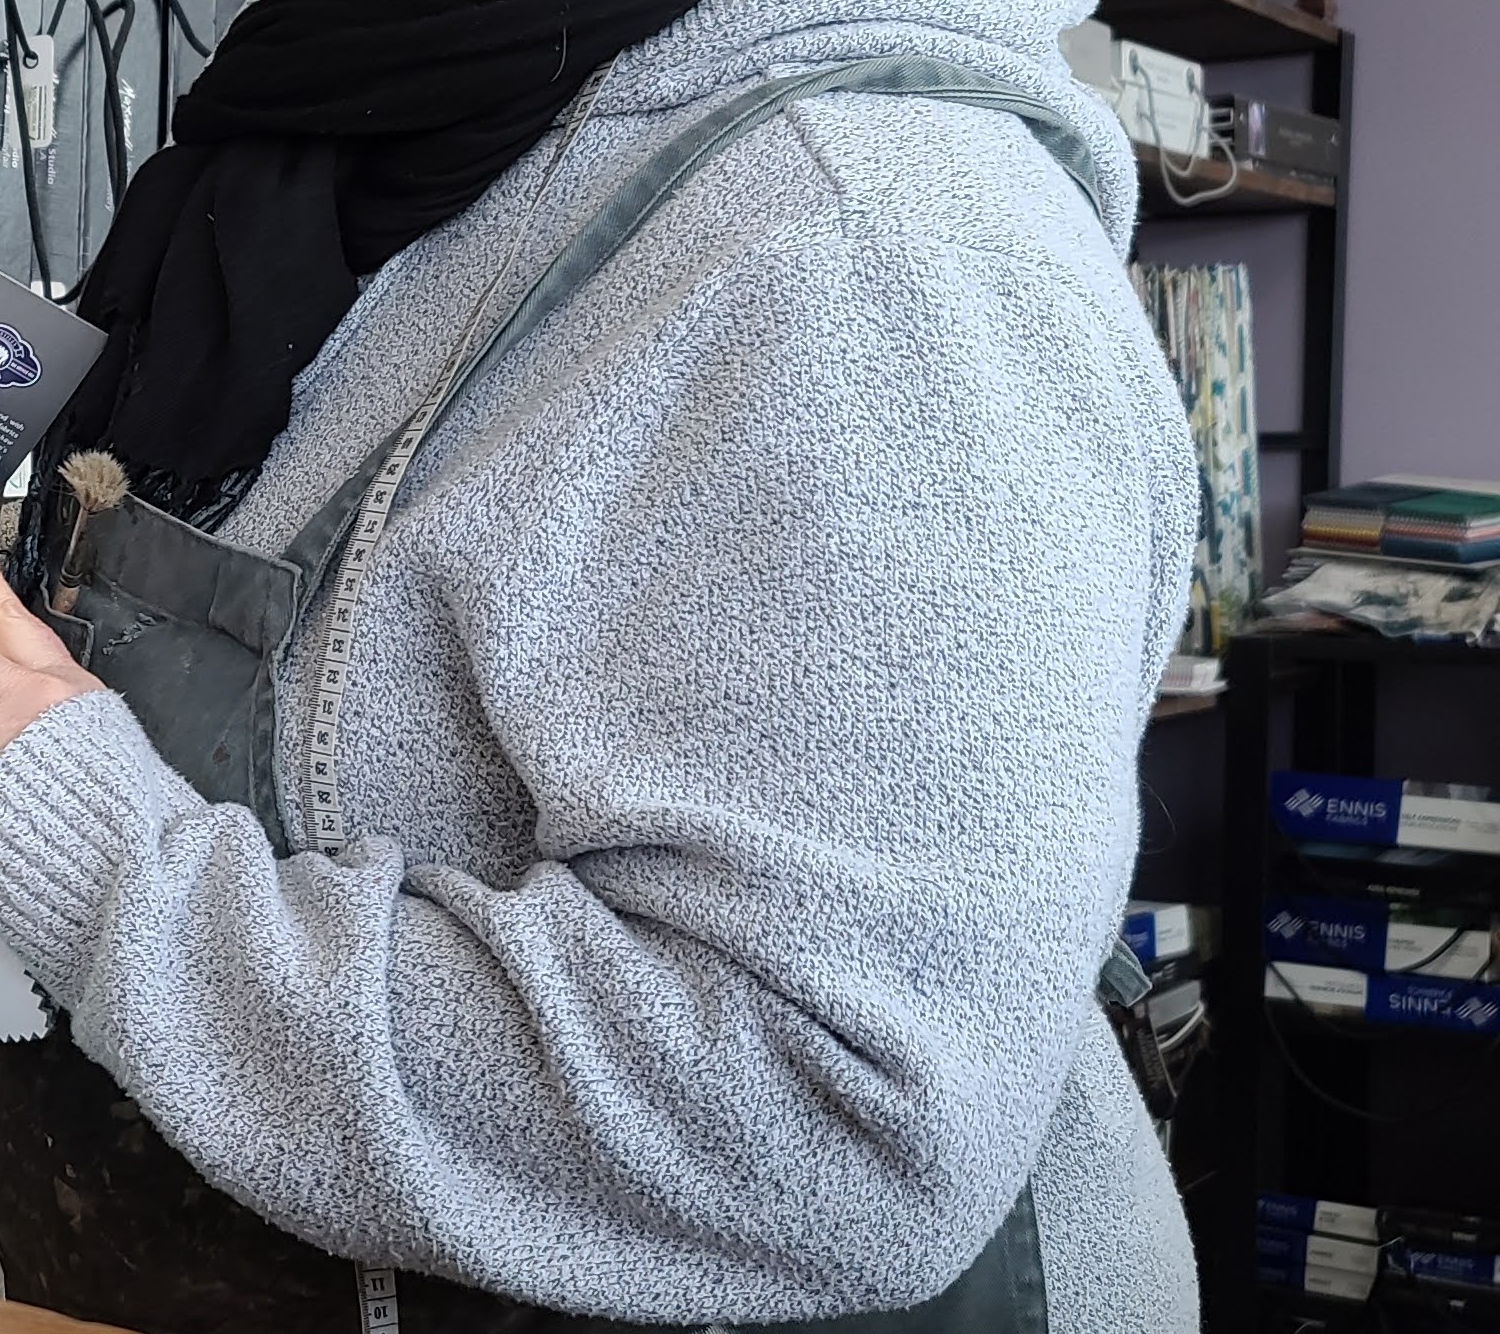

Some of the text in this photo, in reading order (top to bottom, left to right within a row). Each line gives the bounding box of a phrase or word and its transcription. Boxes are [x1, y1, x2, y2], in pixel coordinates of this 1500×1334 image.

[47, 148, 57, 184] Studio
[326, 670, 339, 684] 32
[322, 700, 335, 715] 31
[1326, 798, 1387, 818] ENNIS
[371, 1277, 385, 1292] 11
[374, 1305, 388, 1320] 10
